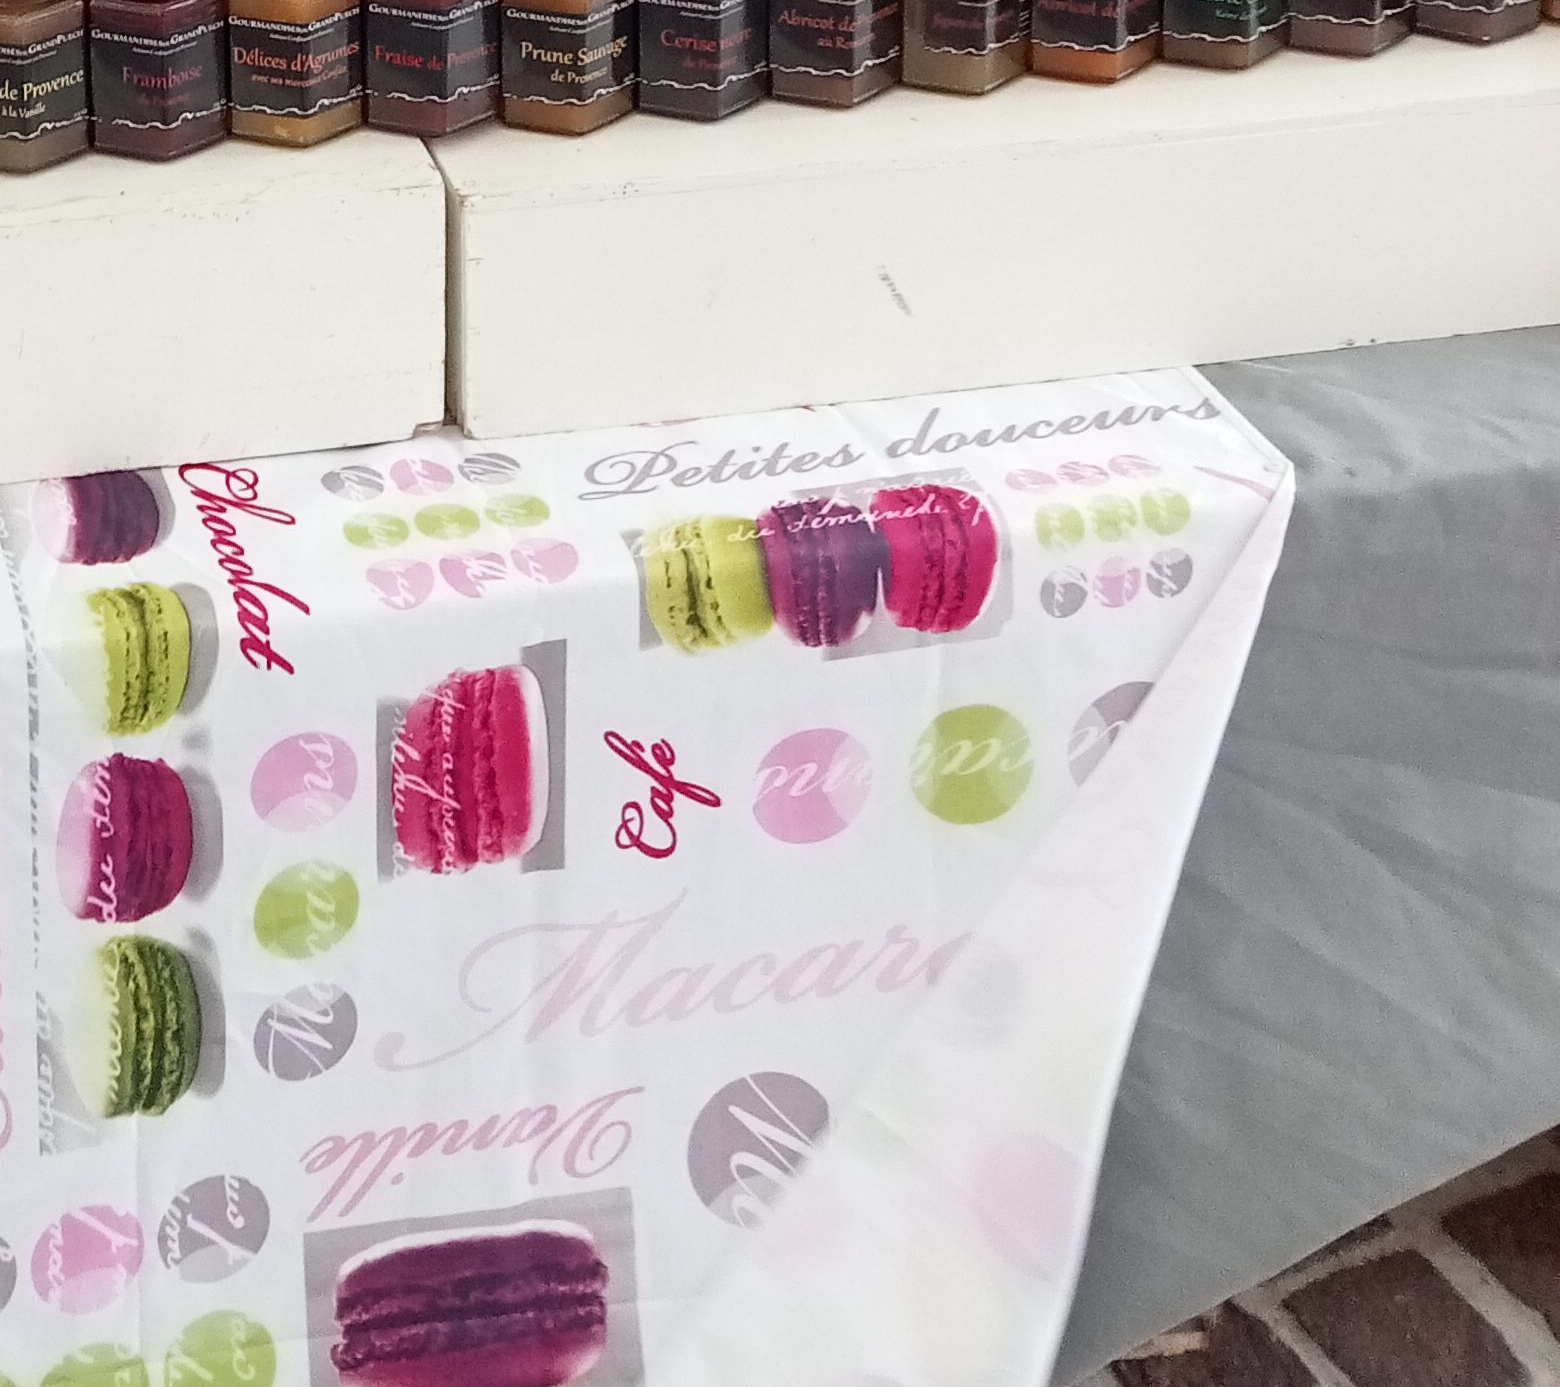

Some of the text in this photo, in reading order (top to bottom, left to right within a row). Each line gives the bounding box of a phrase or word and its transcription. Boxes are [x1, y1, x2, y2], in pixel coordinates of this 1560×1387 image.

[520, 35, 629, 66] Prune Sauvage
[660, 28, 718, 53] Cerise
[232, 40, 361, 74] Délices d'Agrumes
[374, 44, 423, 69] Fraise
[426, 52, 444, 71] de
[22, 68, 85, 102] Provence
[122, 64, 203, 91] Framboise
[550, 68, 565, 83] de
[7, 105, 17, 118] la
[577, 395, 1221, 502] Petites douceurs
[178, 462, 311, 676] Chocolat
[300, 1086, 646, 1223] Vanille
